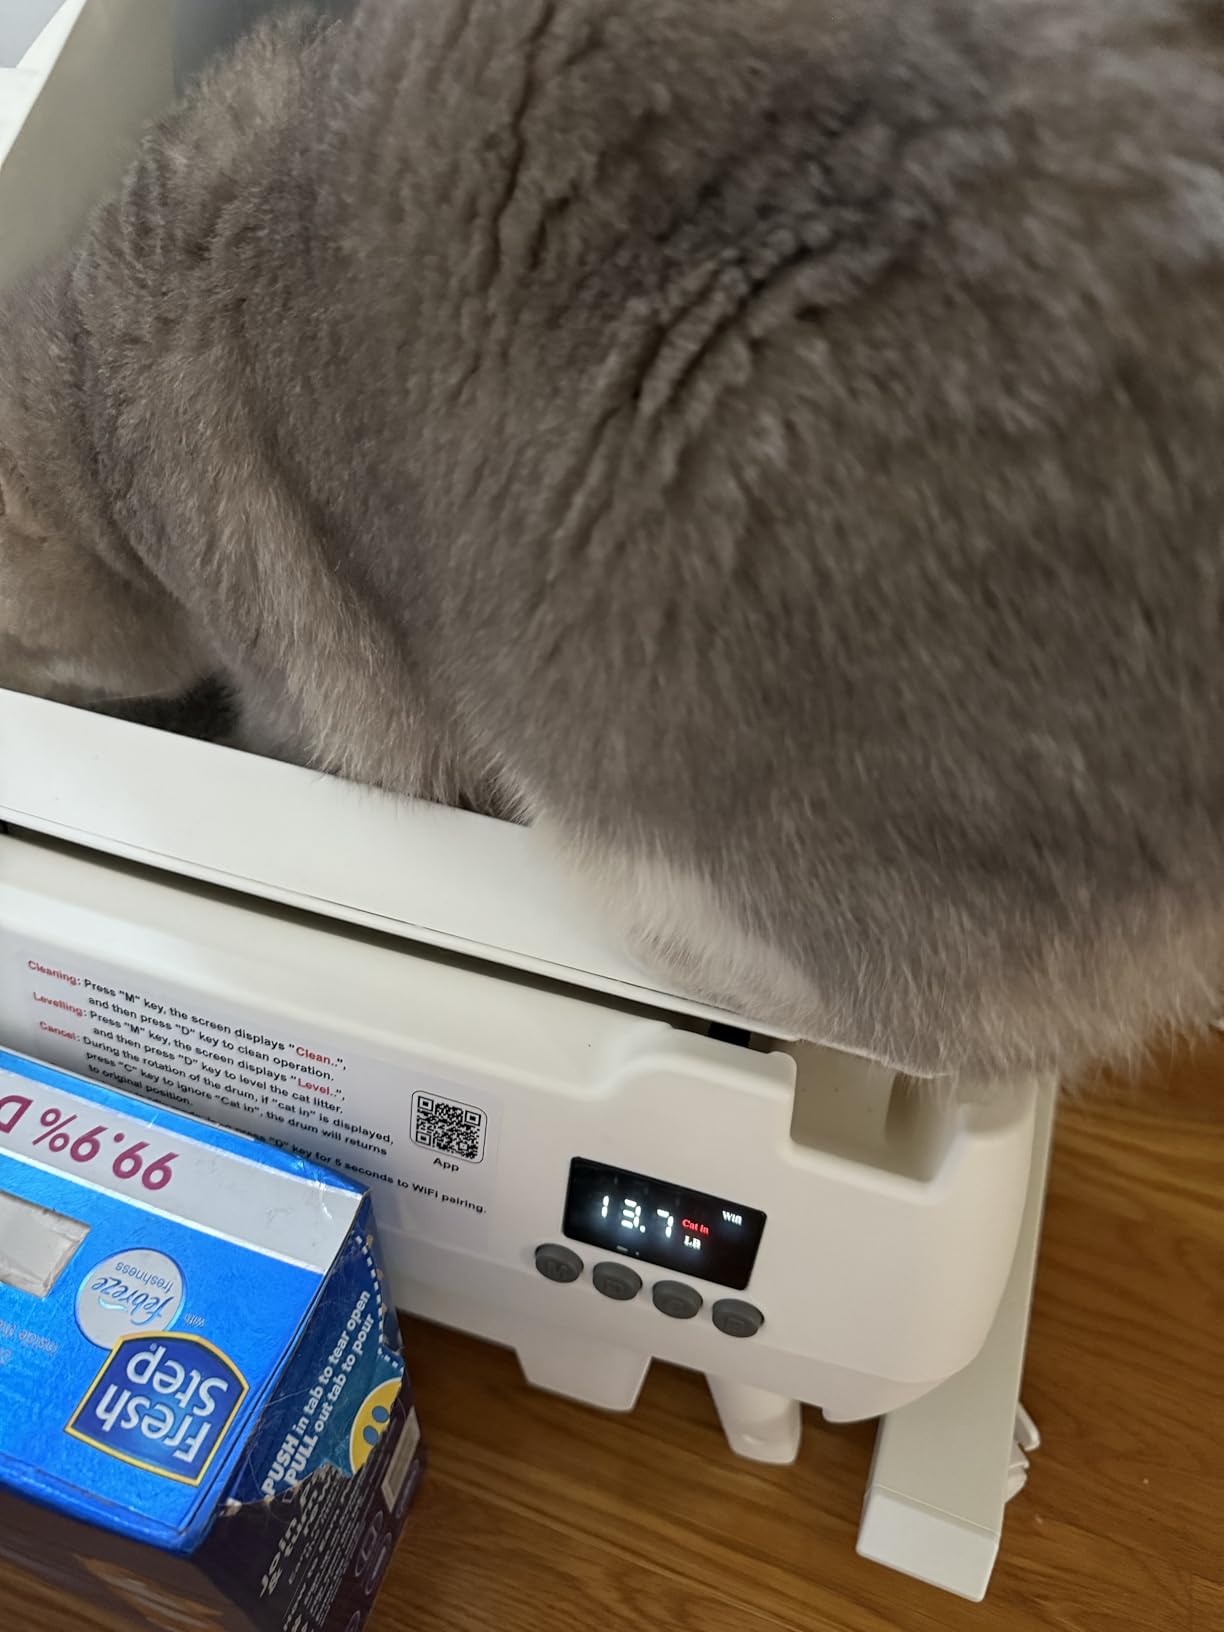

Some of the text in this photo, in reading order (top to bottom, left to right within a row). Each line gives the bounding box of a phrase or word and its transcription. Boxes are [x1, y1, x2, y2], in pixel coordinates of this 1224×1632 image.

[28, 960, 81, 985] Cleaning:
[84, 978, 116, 997] Press
[144, 998, 166, 1014] key,
[169, 1007, 188, 1020] the
[191, 1015, 231, 1034] screen
[235, 1028, 285, 1050] displays
[33, 991, 87, 1017] Levelling:
[90, 1010, 122, 1028] Press
[148, 1030, 171, 1046] key,
[173, 1039, 192, 1052] the
[195, 1046, 234, 1065] screen
[238, 1059, 287, 1082] displays
[88, 997, 109, 1009] and
[111, 1004, 137, 1019] then
[141, 1014, 173, 1030] press
[199, 1031, 219, 1047] key
[222, 1039, 235, 1050] to
[238, 1046, 270, 1062] clean
[273, 1056, 335, 1081] operation.
[39, 1021, 81, 1042] Cancel:
[83, 1036, 120, 1057] During
[122, 1050, 140, 1063] the
[143, 1057, 187, 1078] rotation
[189, 1071, 201, 1082] of
[203, 1077, 222, 1090] the
[224, 1084, 259, 1103] drum,
[261, 1094, 269, 1105] if
[319, 1113, 330, 1124] is
[333, 1118, 394, 1145] displayed,
[86, 1052, 117, 1067] press
[140, 1069, 160, 1083] key
[162, 1076, 175, 1086] to
[177, 1081, 212, 1100] ignore
[266, 1111, 285, 1123] the
[288, 1118, 319, 1134] drum
[321, 1128, 342, 1141] will
[345, 1137, 388, 1156] returns
[88, 1064, 194, 1106] to original position.
[93, 1027, 114, 1039] and
[116, 1034, 141, 1050] then
[144, 1044, 176, 1060] press
[201, 1061, 221, 1077] key
[224, 1069, 237, 1080] to
[239, 1074, 267, 1090] level
[270, 1084, 289, 1097] the
[291, 1092, 311, 1105] cat
[313, 1097, 344, 1114] litter.
[32, 1108, 179, 1190] 99.9%
[315, 1150, 332, 1165] for
[344, 1163, 394, 1184] seconds
[397, 1178, 409, 1189] to
[441, 1195, 487, 1214] pairing.
[432, 1157, 460, 1172] App
[601, 1195, 674, 1239] 13.7
[115, 1262, 176, 1294] freshness
[126, 1345, 229, 1417] Step
[261, 1290, 371, 1497] PUSH in tab to tear open
[284, 1313, 375, 1486] PULL out tab to pour
[95, 1383, 212, 1463] Fresh
